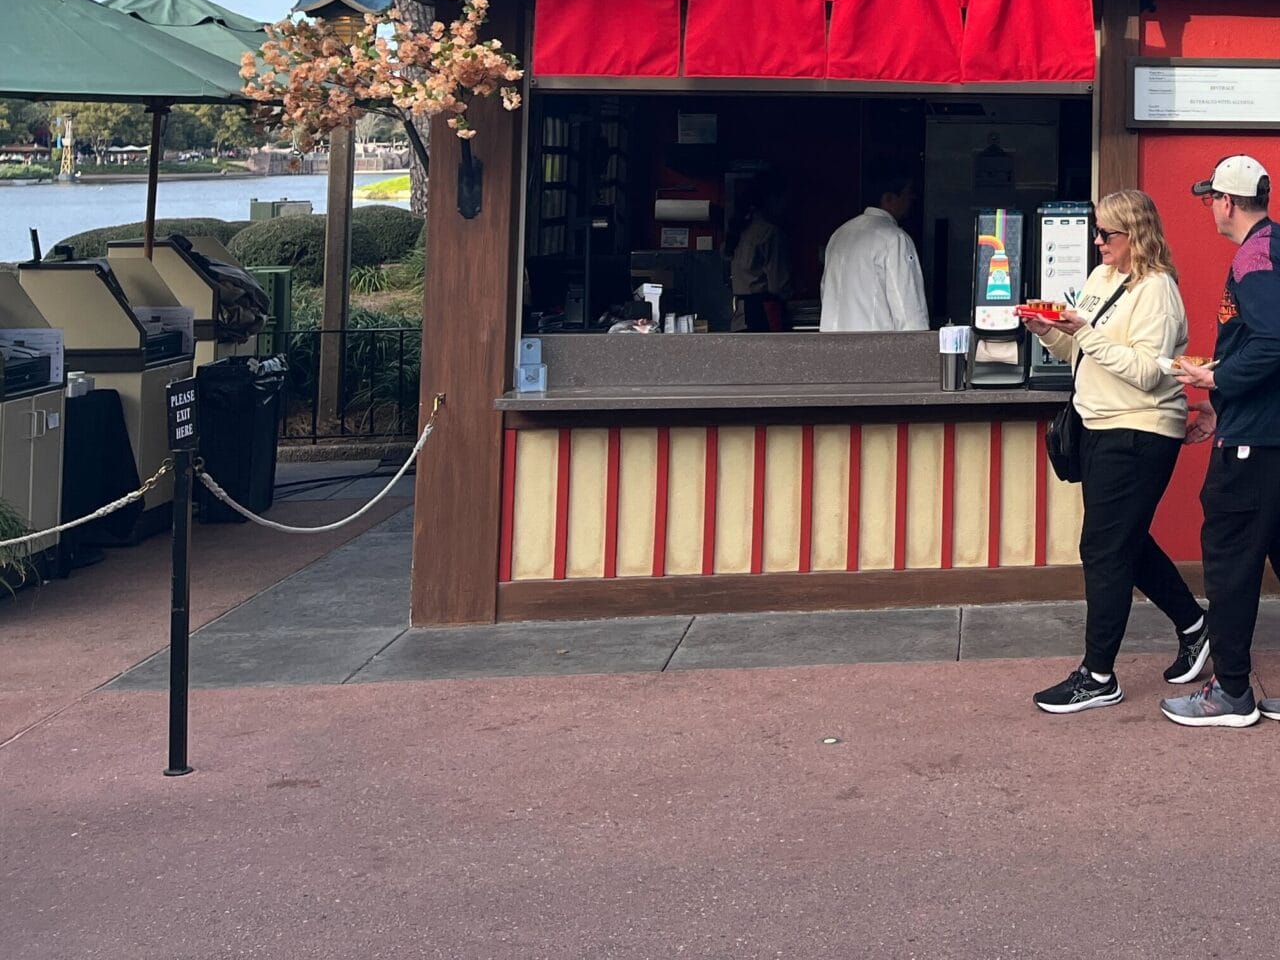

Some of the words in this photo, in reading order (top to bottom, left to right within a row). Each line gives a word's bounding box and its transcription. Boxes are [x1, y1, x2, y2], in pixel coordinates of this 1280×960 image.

[170, 390, 195, 407] PLEASE
[176, 407, 191, 422] EXIT
[176, 423, 193, 440] HERE
